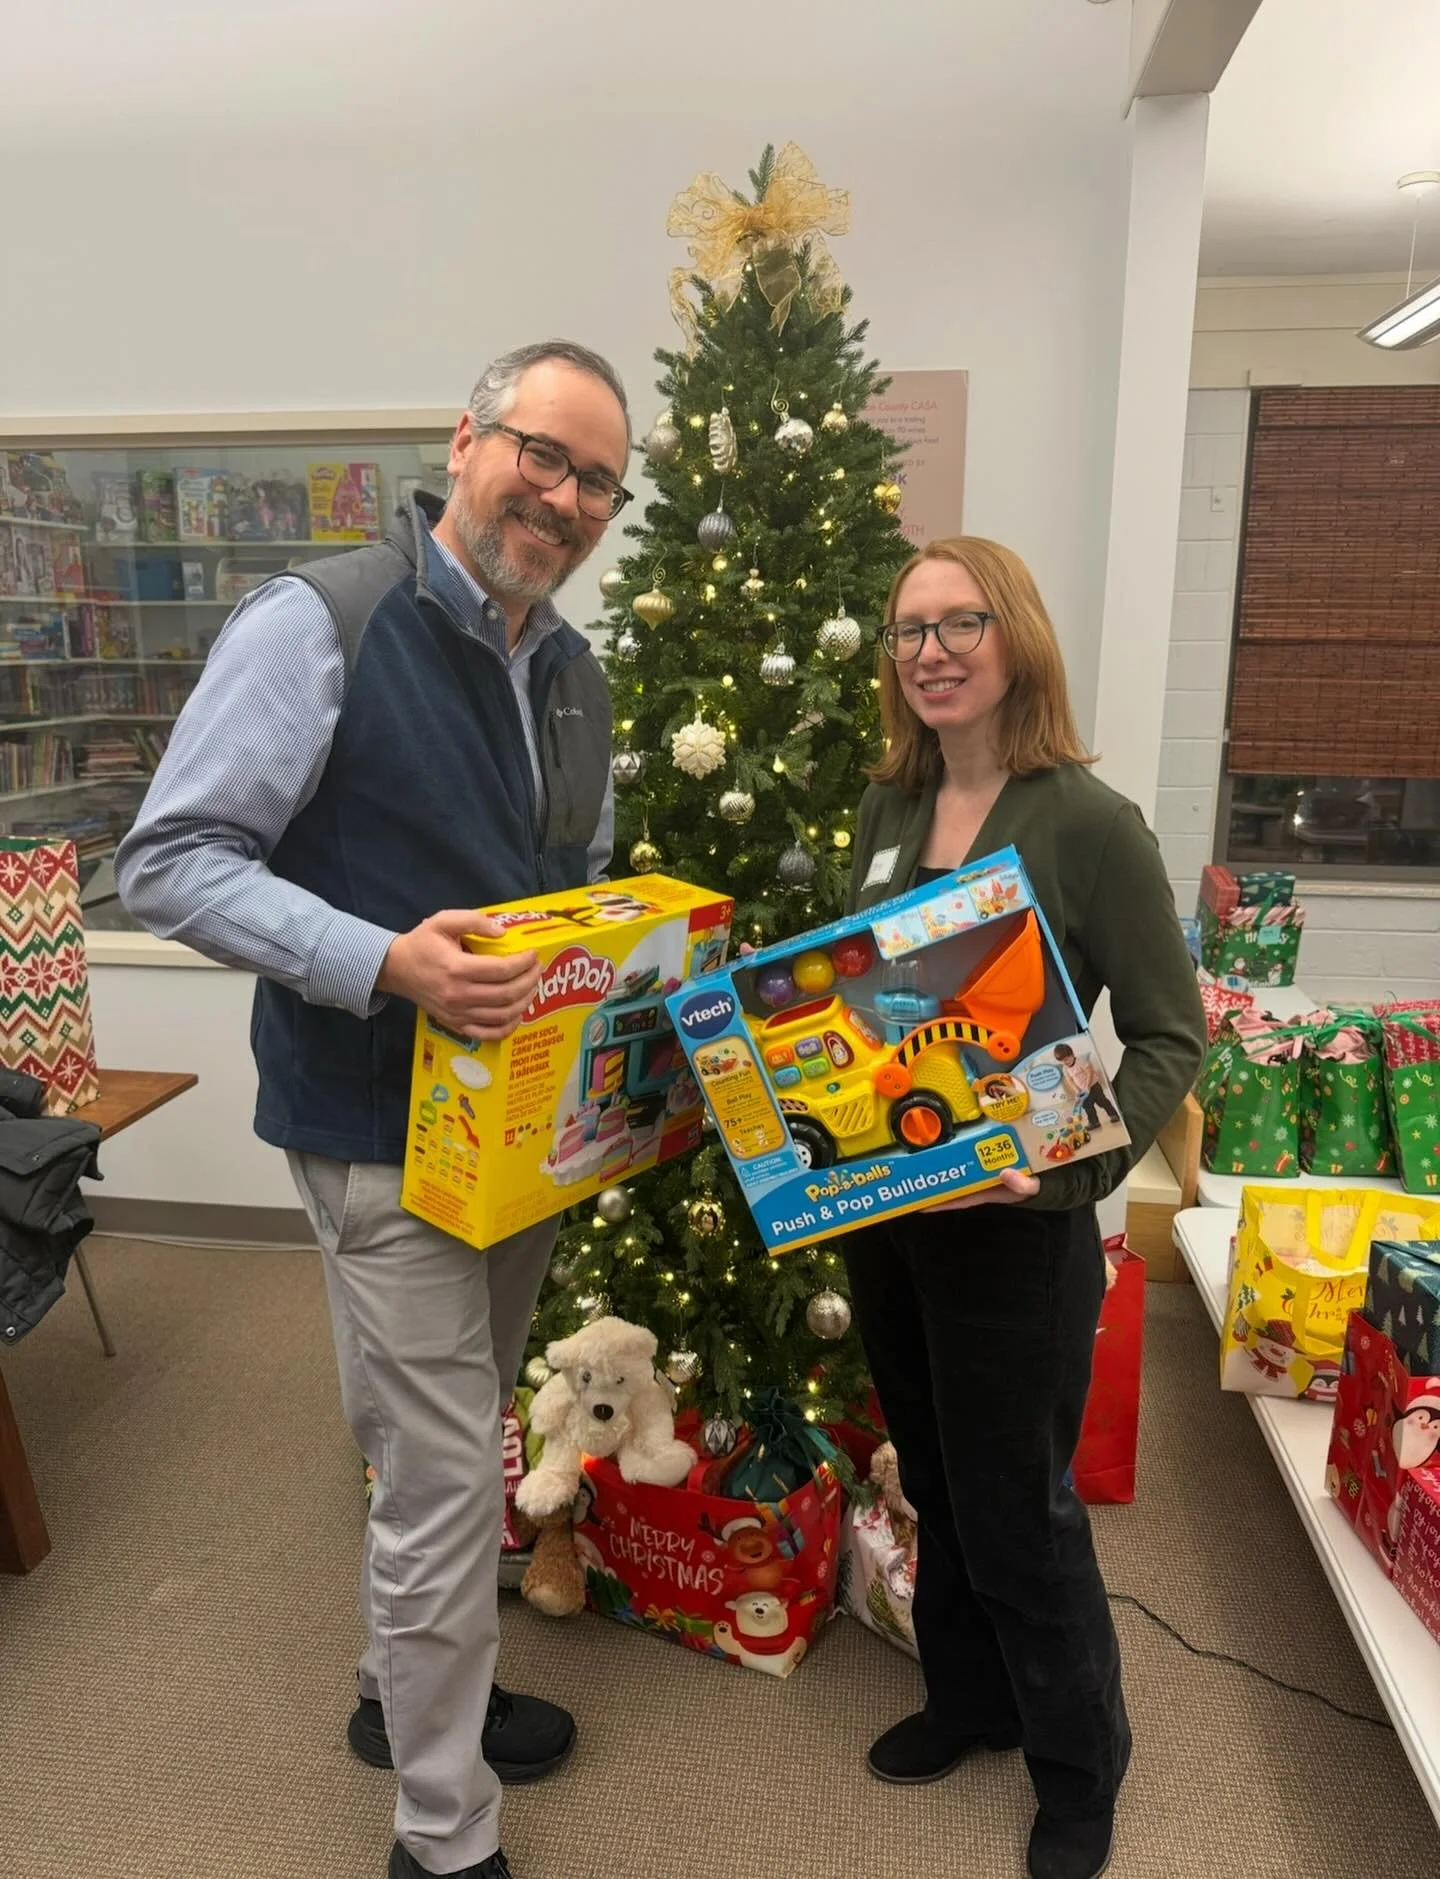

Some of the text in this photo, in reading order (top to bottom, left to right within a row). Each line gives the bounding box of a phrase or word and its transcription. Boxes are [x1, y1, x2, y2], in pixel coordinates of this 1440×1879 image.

[911, 400, 937, 411] CASA
[719, 903, 732, 920] 3+
[528, 957, 611, 1015] lay-Doh
[681, 1000, 732, 1027] vtech
[711, 1074, 739, 1087] Counting
[724, 1115, 743, 1129] 75+
[979, 1139, 1012, 1157] 12-36
[984, 1151, 1015, 1166] Months
[771, 1163, 968, 1236] Push & Pop Bulldozer
[630, 1516, 695, 1562] MERRY
[609, 1533, 724, 1595] CHRISTMAS
